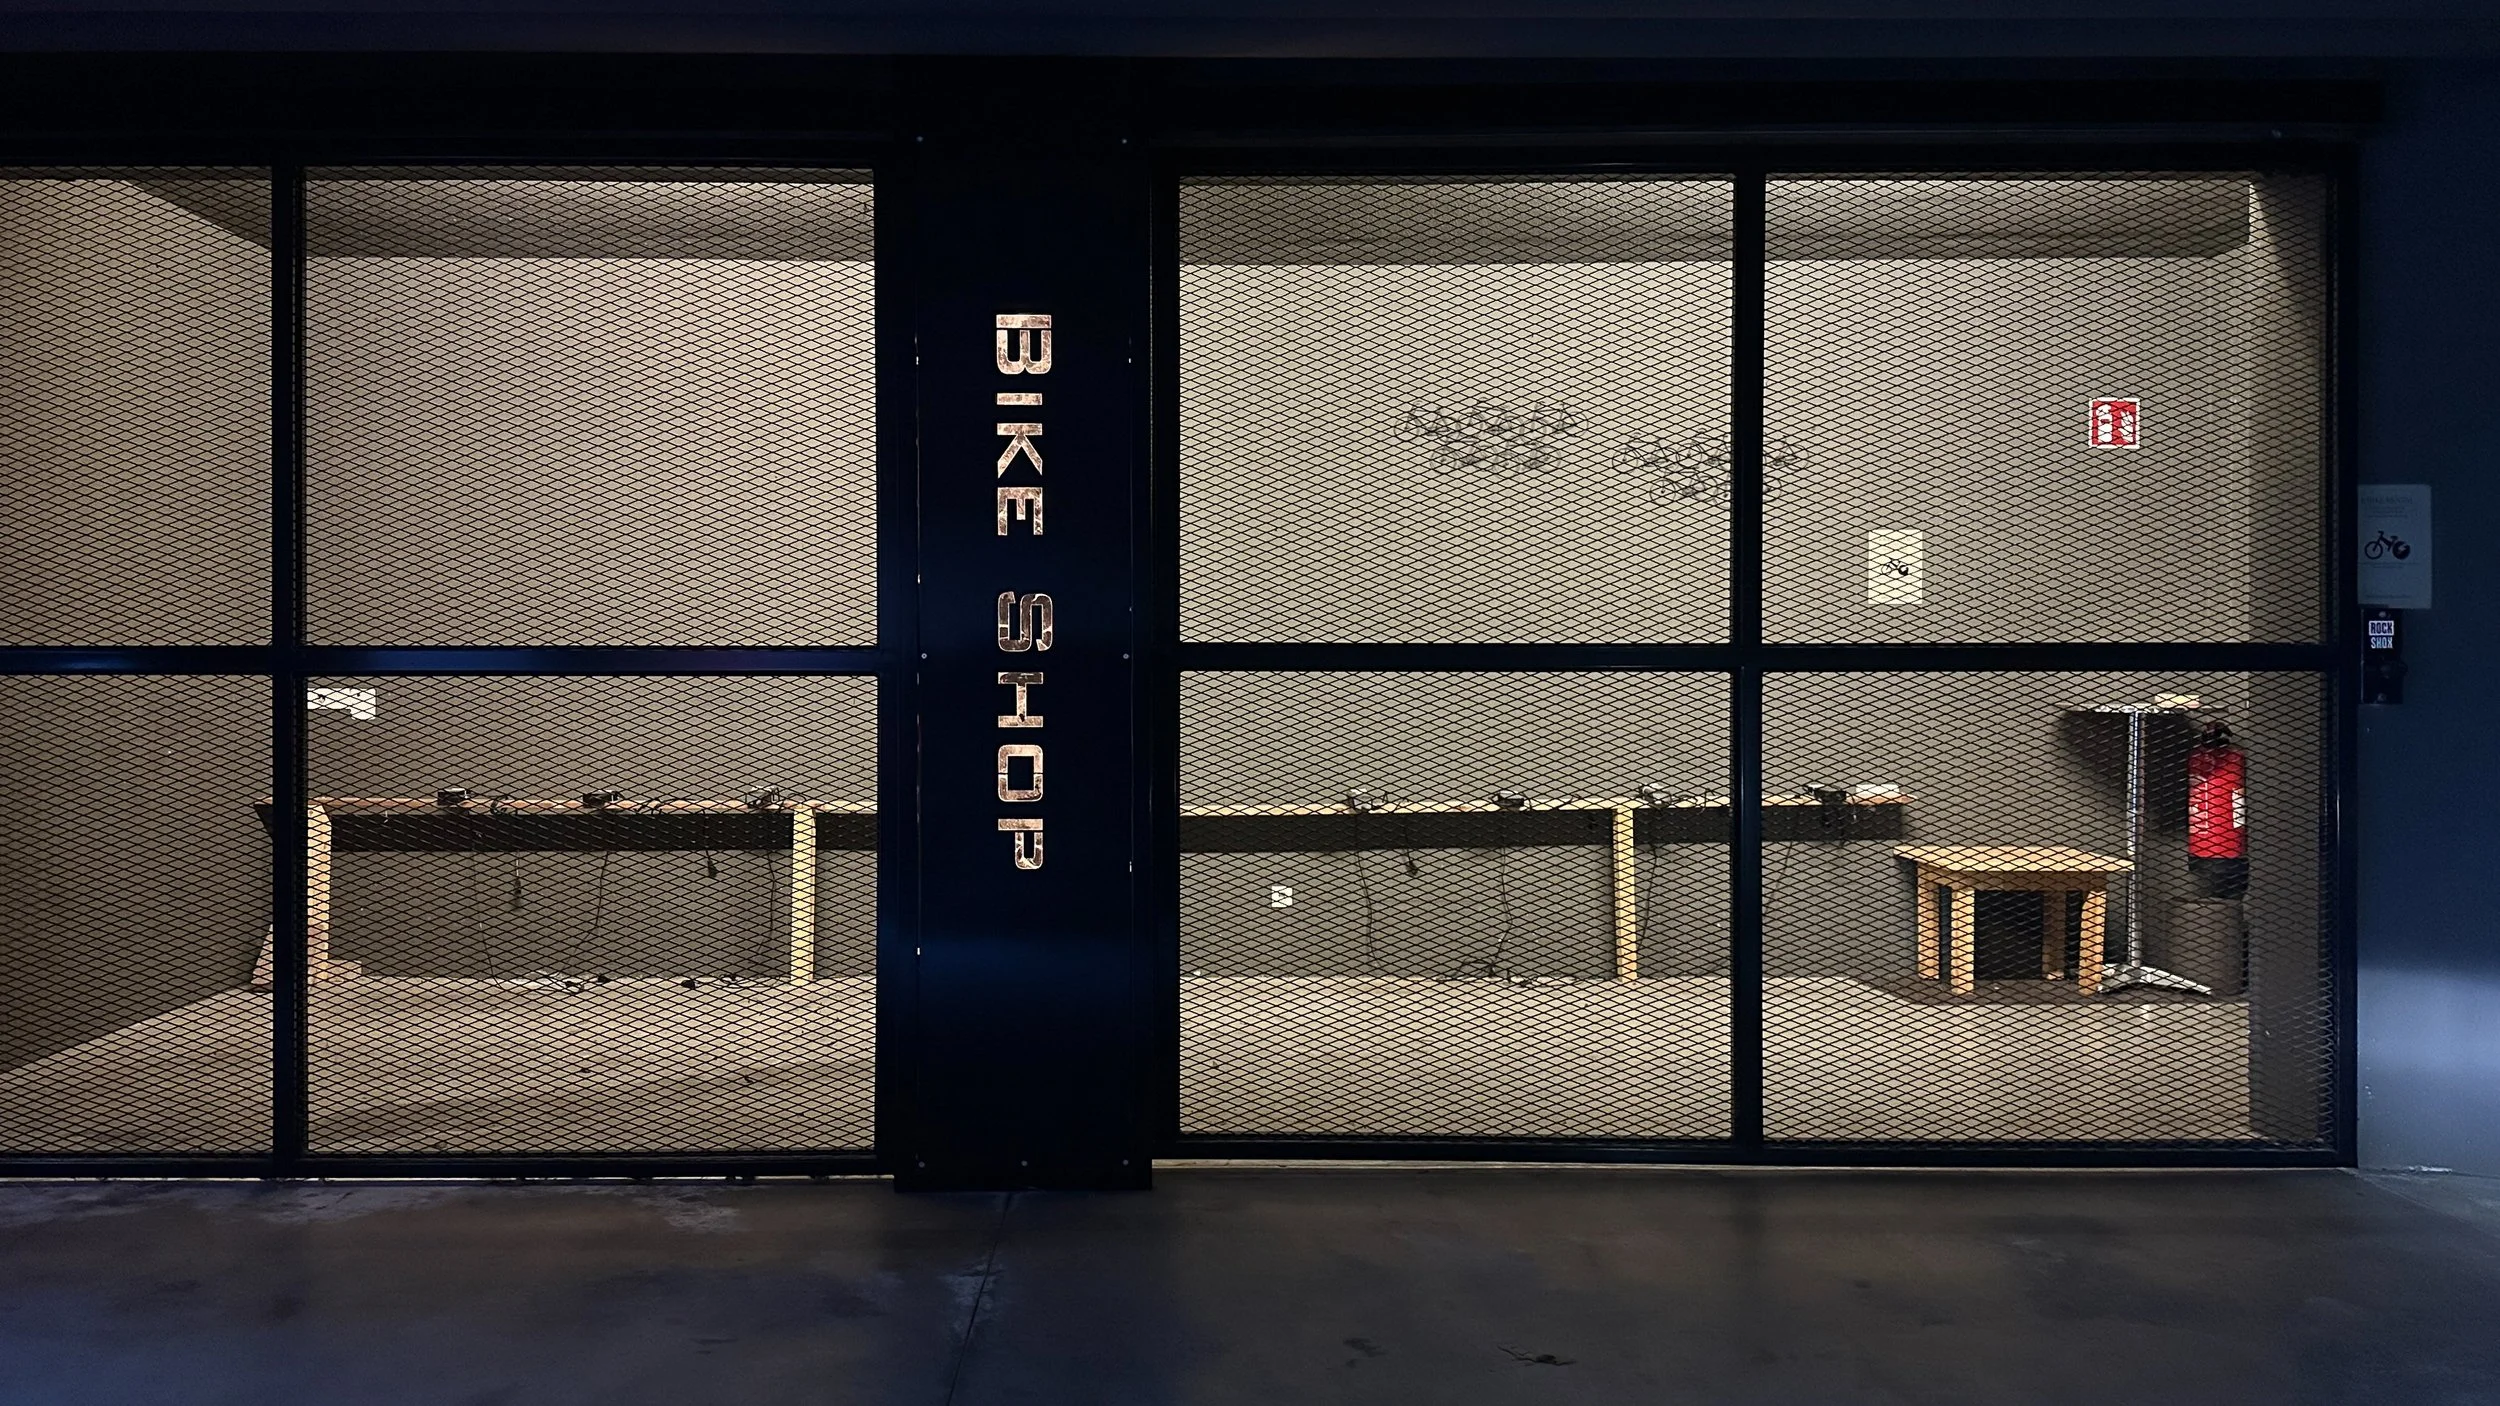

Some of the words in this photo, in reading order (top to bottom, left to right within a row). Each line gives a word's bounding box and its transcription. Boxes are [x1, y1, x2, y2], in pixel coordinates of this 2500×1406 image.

[996, 313, 1052, 535] BIKE
[2370, 622, 2393, 634] ROCK
[2370, 637, 2393, 649] SHOX
[997, 591, 1053, 869] SHOP
